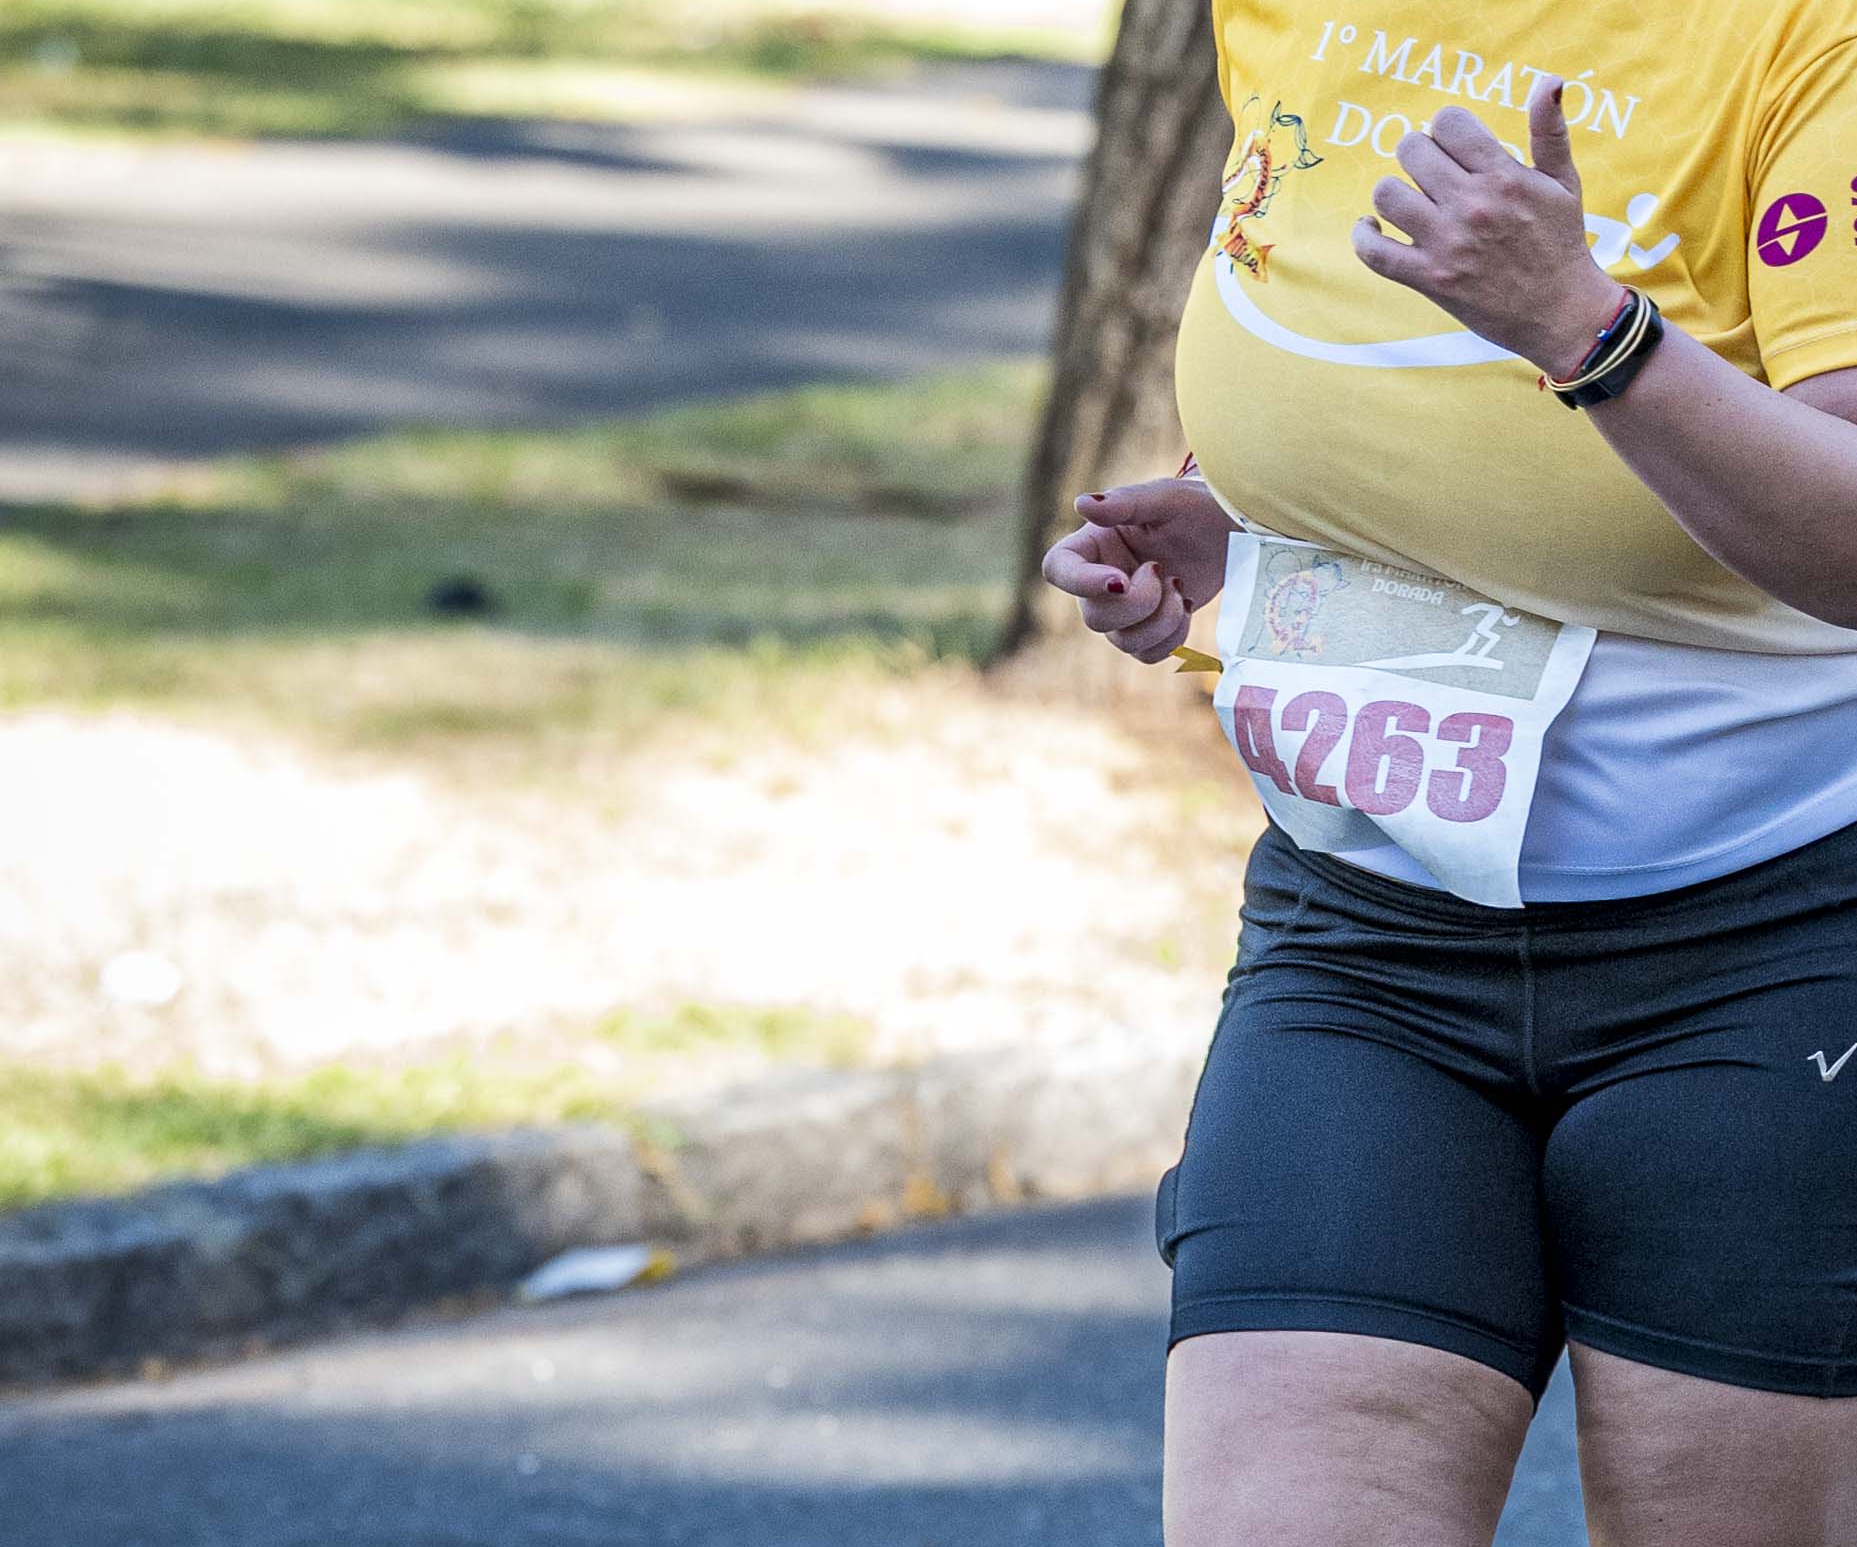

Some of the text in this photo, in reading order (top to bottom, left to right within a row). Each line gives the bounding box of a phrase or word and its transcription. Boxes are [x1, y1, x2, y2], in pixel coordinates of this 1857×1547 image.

[1359, 29, 1642, 140] MARATÓN
[1372, 578, 1445, 605] DORADA
[1233, 684, 1515, 823] 4263
